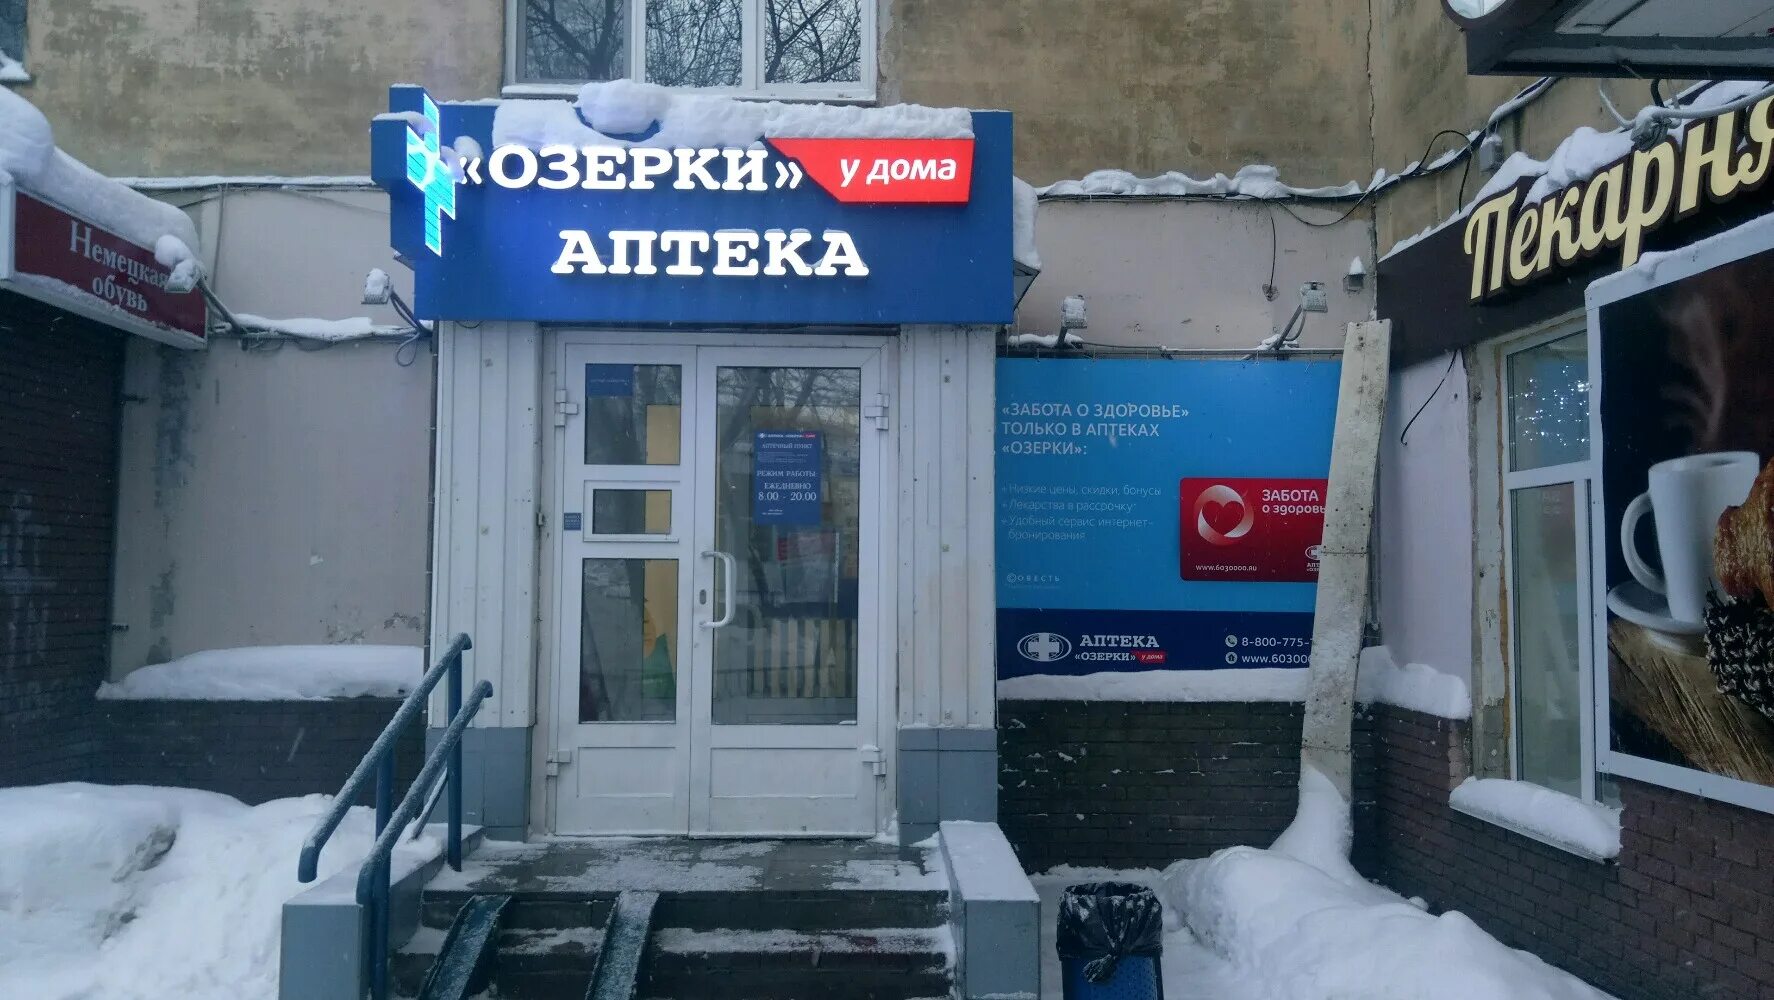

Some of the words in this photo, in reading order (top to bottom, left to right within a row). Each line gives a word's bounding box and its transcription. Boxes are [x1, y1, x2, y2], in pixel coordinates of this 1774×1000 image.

[459, 144, 803, 191] «ОЗЕРКИ»
[840, 159, 861, 187] у
[865, 159, 957, 185] дома
[551, 230, 870, 276] АПТЕКА
[92, 274, 148, 312] обувь
[1002, 403, 1073, 416] «ЗАБОТА
[1076, 403, 1089, 417] О
[1094, 404, 1189, 419] ЗДОРОВЬЕ»
[1002, 421, 1067, 435] ТОЛЬКО
[1072, 423, 1081, 436] В
[1086, 423, 1160, 437] АПТЕКАХ
[1002, 441, 1087, 455] «ОЗЕРКИ»:
[758, 491, 779, 501] 8.00
[790, 491, 817, 501] 20.00
[1123, 485, 1162, 497] бонусы
[1262, 489, 1319, 501] ЗАБОТА
[1262, 504, 1270, 513] о
[1009, 515, 1056, 527] Удобный
[1058, 518, 1095, 528] сервис
[1008, 529, 1086, 541] бронирования
[1079, 634, 1160, 648] АПТЕКА
[1075, 652, 1136, 661] «ОЗЕРКИ»
